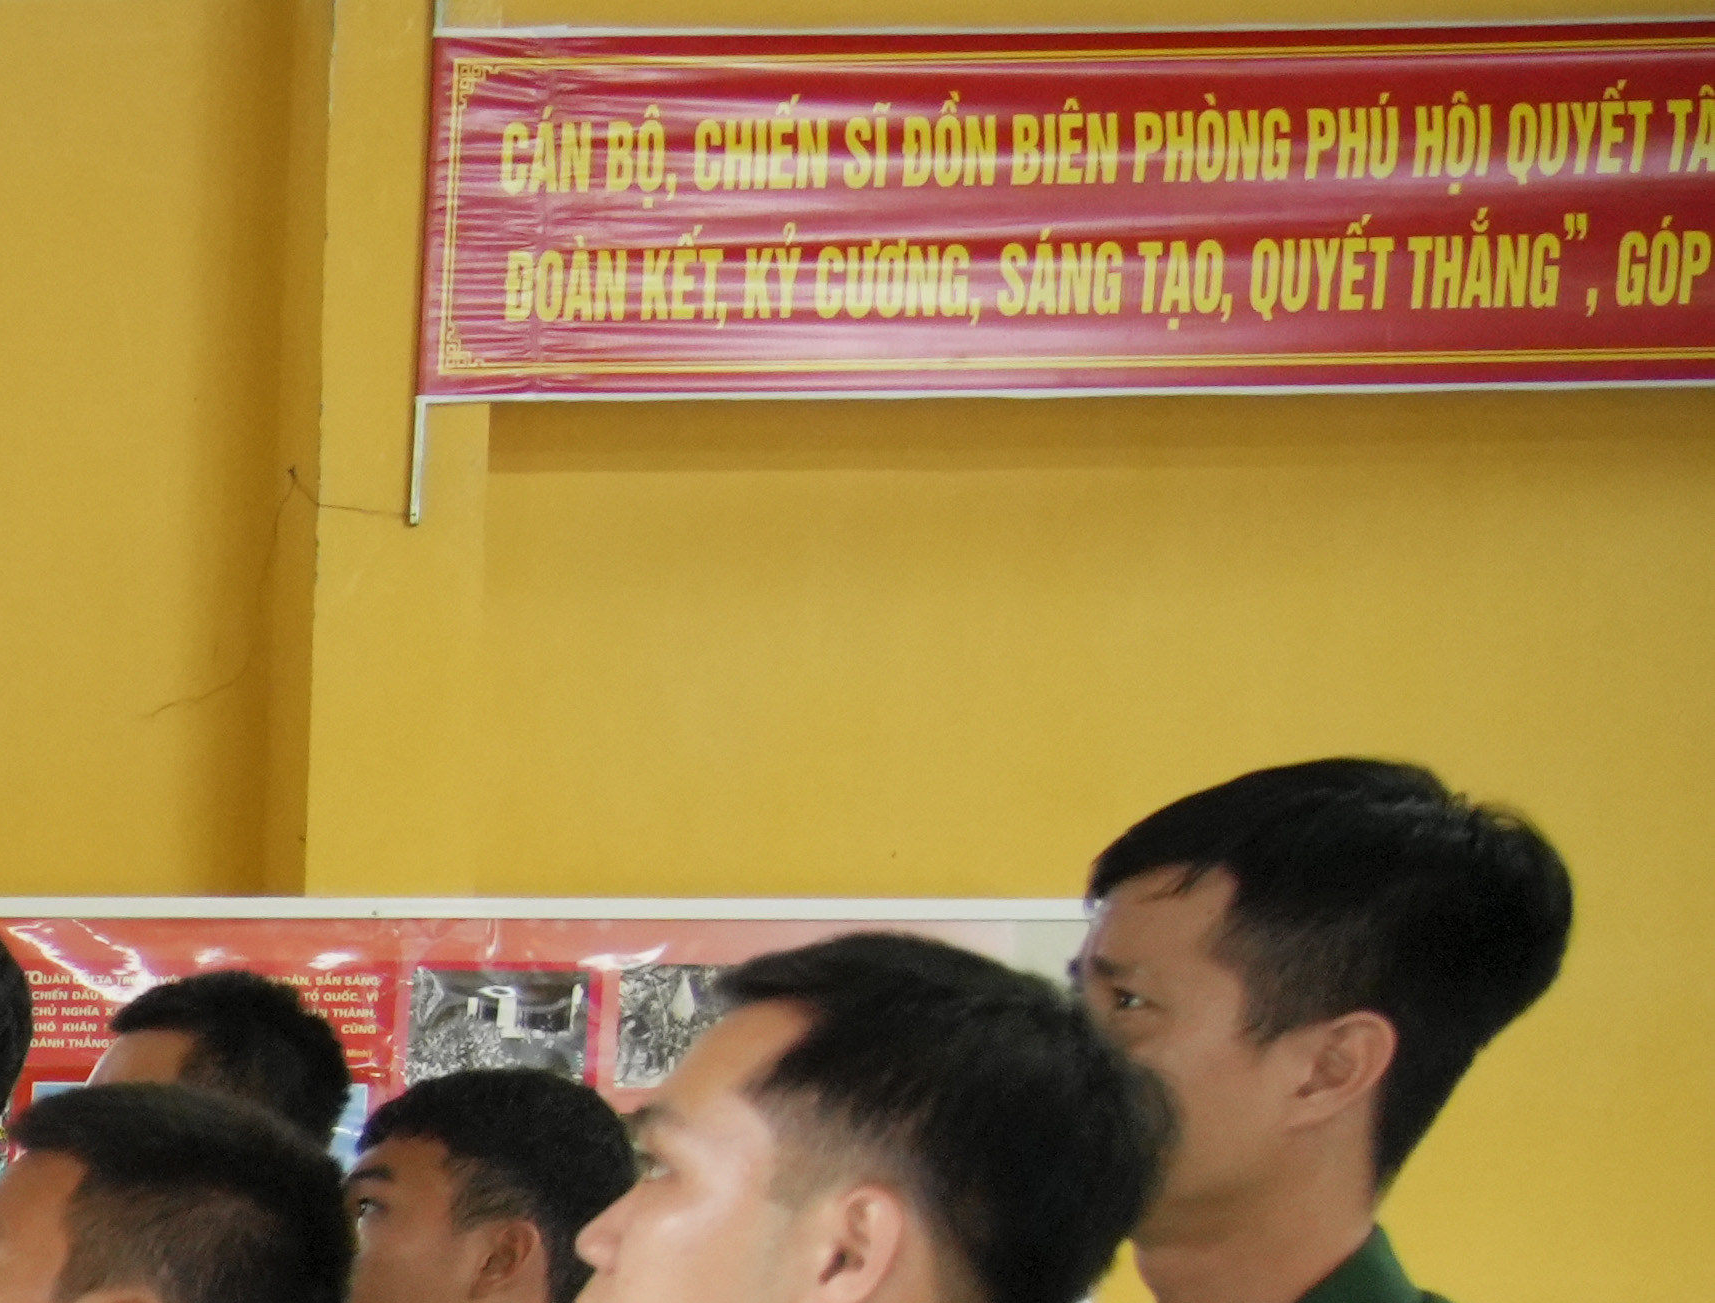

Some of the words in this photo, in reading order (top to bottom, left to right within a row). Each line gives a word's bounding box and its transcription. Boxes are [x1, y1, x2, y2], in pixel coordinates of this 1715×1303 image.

[500, 107, 592, 195] CÁN
[606, 104, 678, 209] BỘ,
[693, 94, 830, 192] CHIẾN
[844, 102, 892, 189] SĨ
[901, 91, 997, 188] ĐỒN
[1010, 97, 1119, 186] BIÊN
[1132, 93, 1291, 183] PHÒNG
[1304, 93, 1400, 180] PHÚ
[1413, 90, 1492, 195] HỘI
[1506, 79, 1654, 185] QUYẾT
[503, 235, 627, 322] ĐOÀN
[640, 225, 729, 329] KẾT,
[742, 222, 802, 319] KỶ
[815, 238, 981, 325] CƯƠNG,
[996, 227, 1123, 317] SÁNG
[1138, 239, 1234, 330] TẠO,
[1249, 214, 1394, 321] QUYẾT
[1616, 216, 1712, 307] GÓP
[31, 989, 68, 1000] CHIẾN
[61, 1005, 100, 1016] NGHĨA
[62, 1021, 98, 1032] KHĂN
